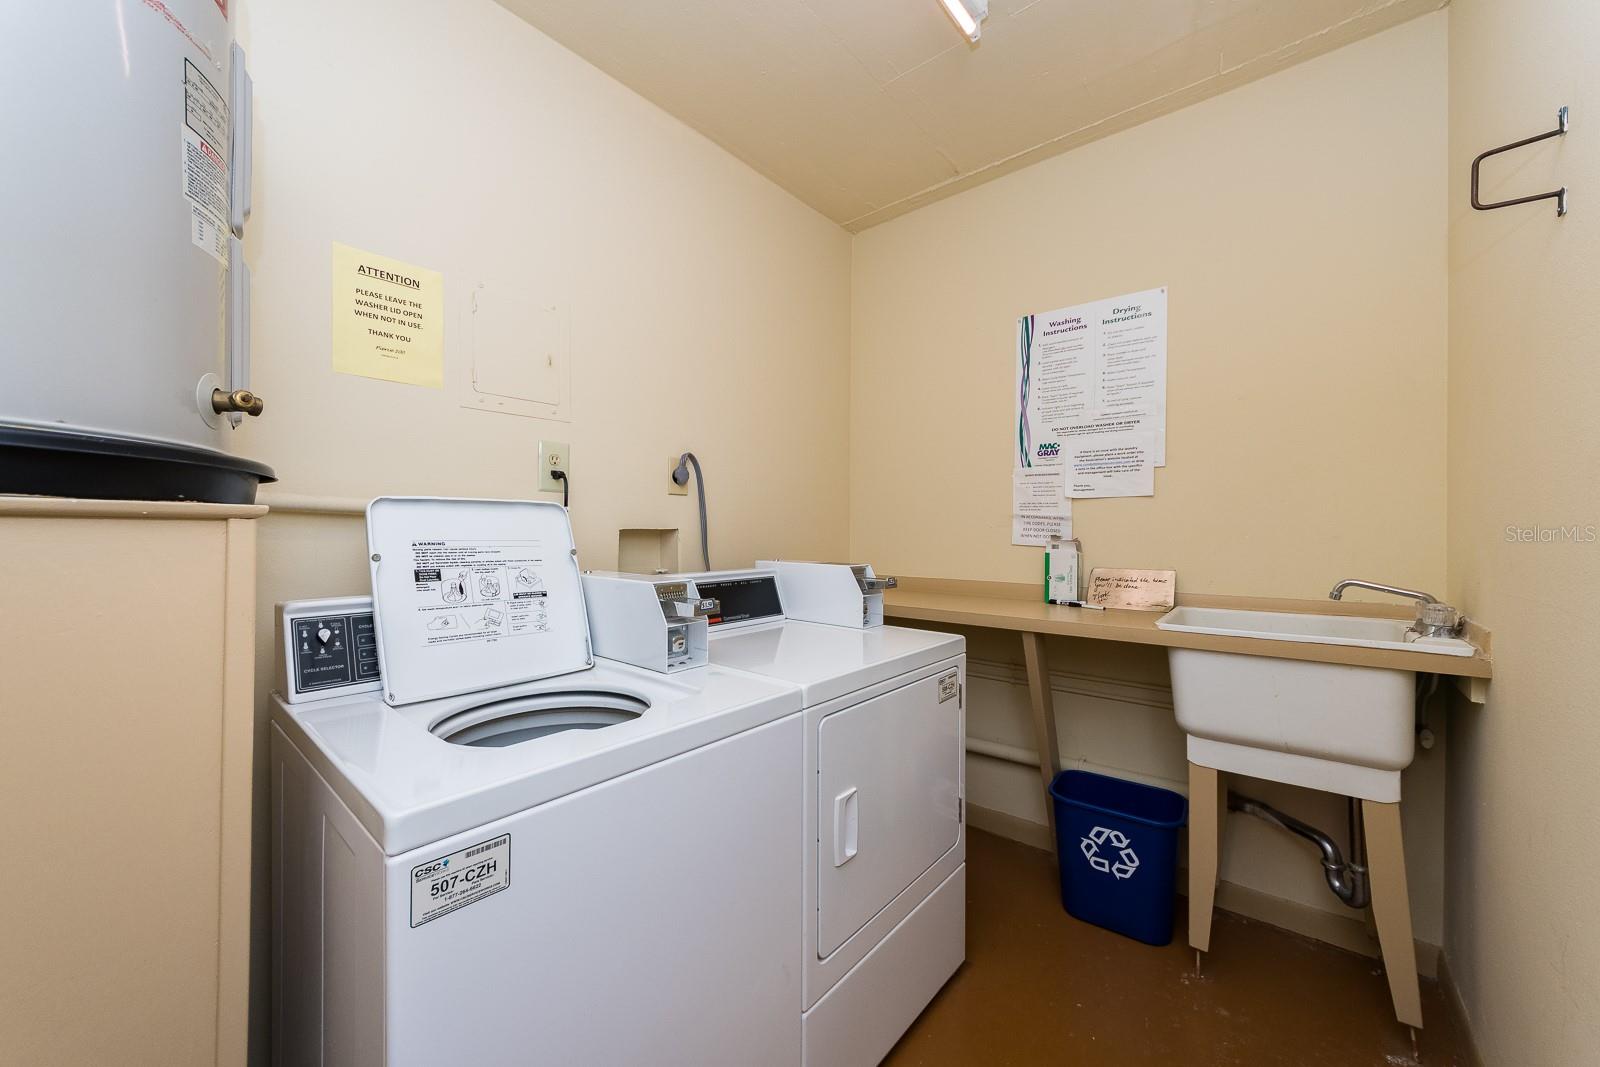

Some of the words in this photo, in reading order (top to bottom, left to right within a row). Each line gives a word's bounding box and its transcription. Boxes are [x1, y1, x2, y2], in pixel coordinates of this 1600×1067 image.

[358, 264, 420, 289] ATTENTION
[355, 288, 383, 300] PLEASE
[384, 295, 407, 306] LEAVE
[409, 301, 423, 310] THE
[355, 298, 388, 312] WASHER
[390, 307, 402, 315] LID
[402, 310, 423, 320] OPEN
[1112, 304, 1142, 316] Drying
[354, 309, 379, 320] WHEN
[380, 315, 396, 324] NOT
[407, 322, 424, 330] USE.
[1048, 316, 1082, 328] Washing
[1102, 310, 1152, 326] Instructions
[368, 328, 394, 340] THANK
[395, 334, 412, 343] YOU
[1042, 324, 1088, 337] Instructions
[1037, 448, 1060, 457] GRAY
[415, 863, 441, 878] CSC
[431, 860, 497, 896] 507-CZH
